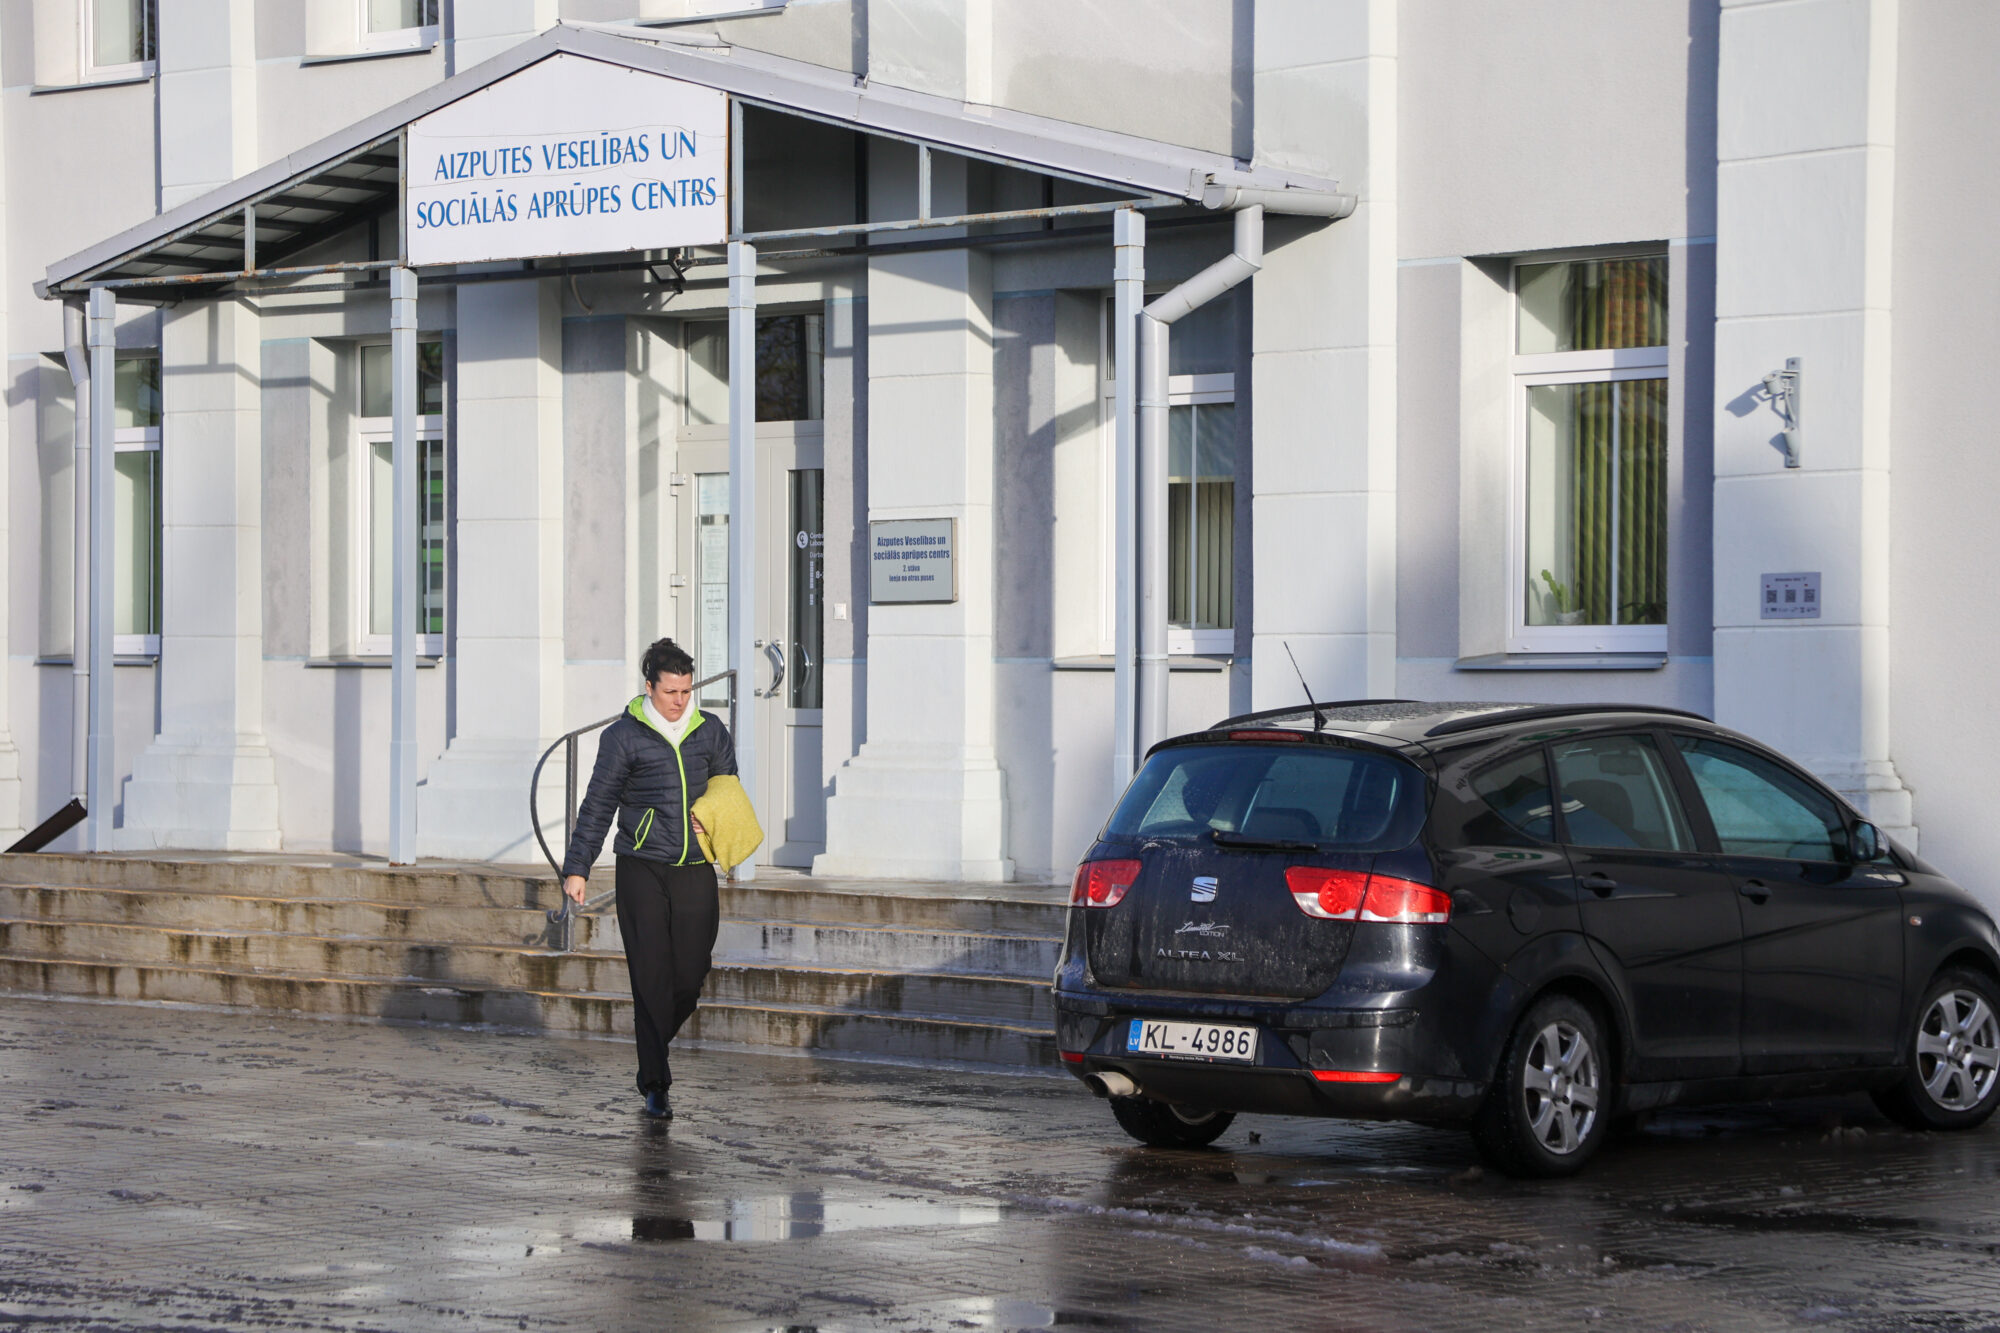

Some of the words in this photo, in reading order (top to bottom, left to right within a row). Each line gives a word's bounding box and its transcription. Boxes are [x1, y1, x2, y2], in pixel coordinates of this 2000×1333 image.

[434, 145, 532, 181] AIZPUTES
[542, 131, 649, 171] VESELĪBAS
[660, 130, 696, 160] UN
[416, 189, 518, 229] SOCIĀLĀS
[527, 182, 622, 220] APRŪPES
[632, 176, 716, 211] CENTRS
[877, 536, 904, 548] Aizputes
[937, 536, 946, 545] un
[928, 549, 950, 559] centrs
[1199, 930, 1225, 938] EDITION
[1157, 948, 1211, 960] ALTEA
[1217, 951, 1245, 962] XL
[1129, 1037, 1140, 1046] LV
